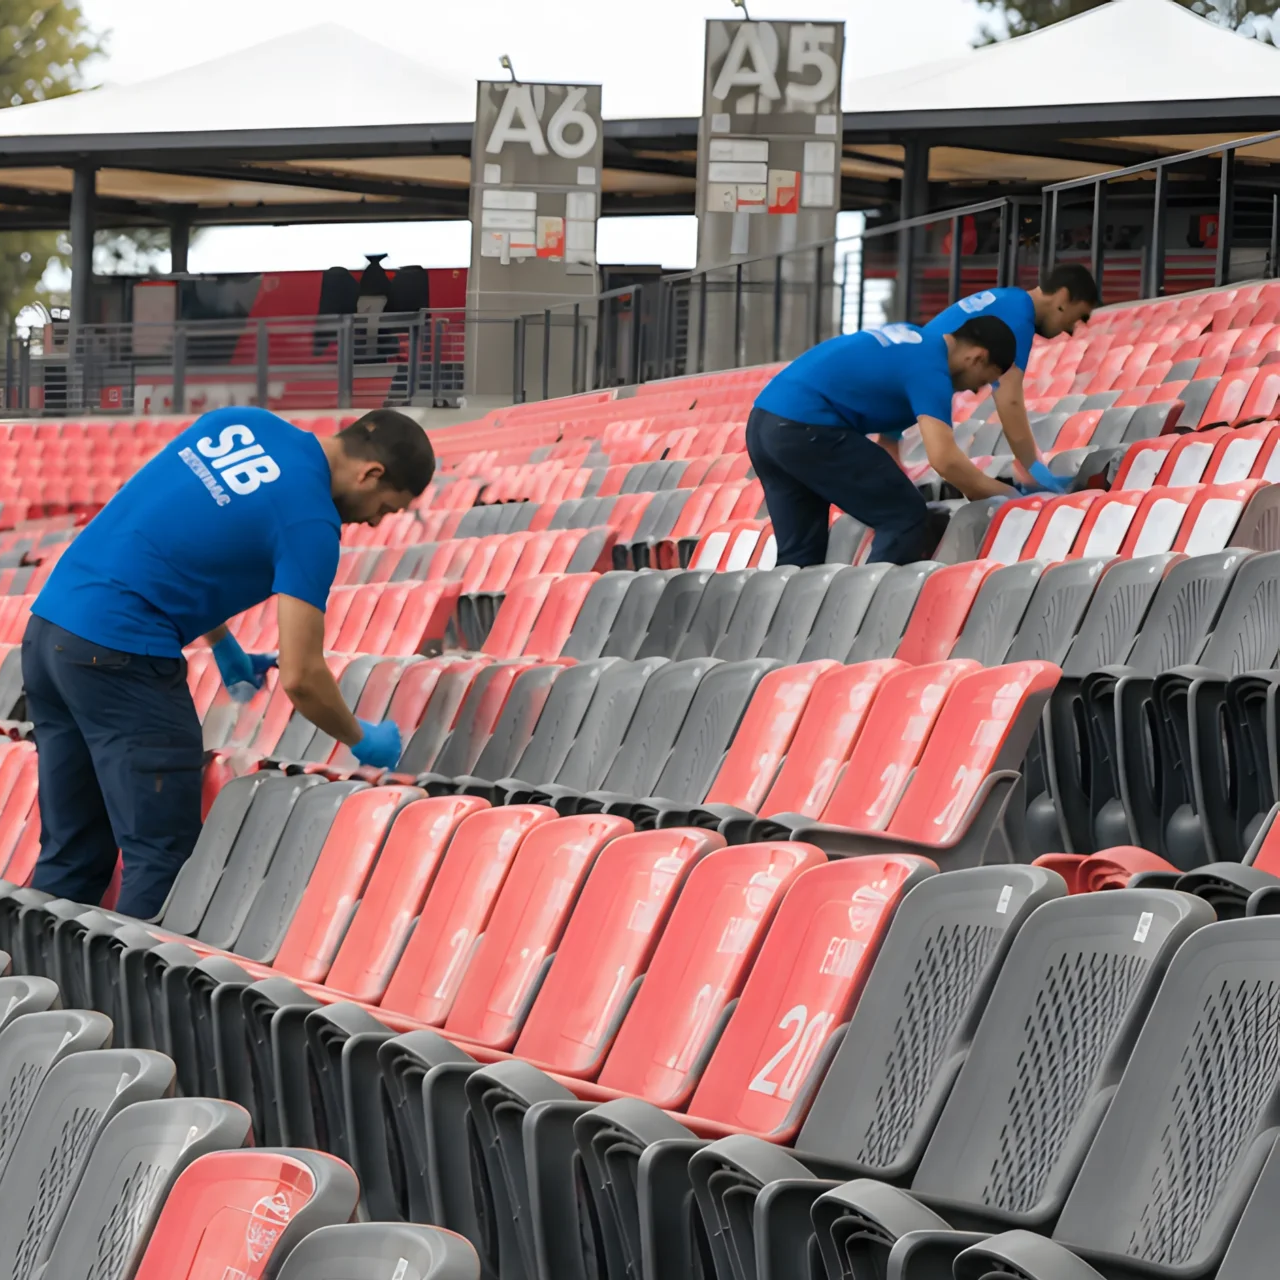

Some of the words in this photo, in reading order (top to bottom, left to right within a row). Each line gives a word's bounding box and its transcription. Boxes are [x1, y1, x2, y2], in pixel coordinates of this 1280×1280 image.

[712, 22, 838, 103] A5
[486, 84, 597, 159] A6
[196, 424, 281, 495] SIB
